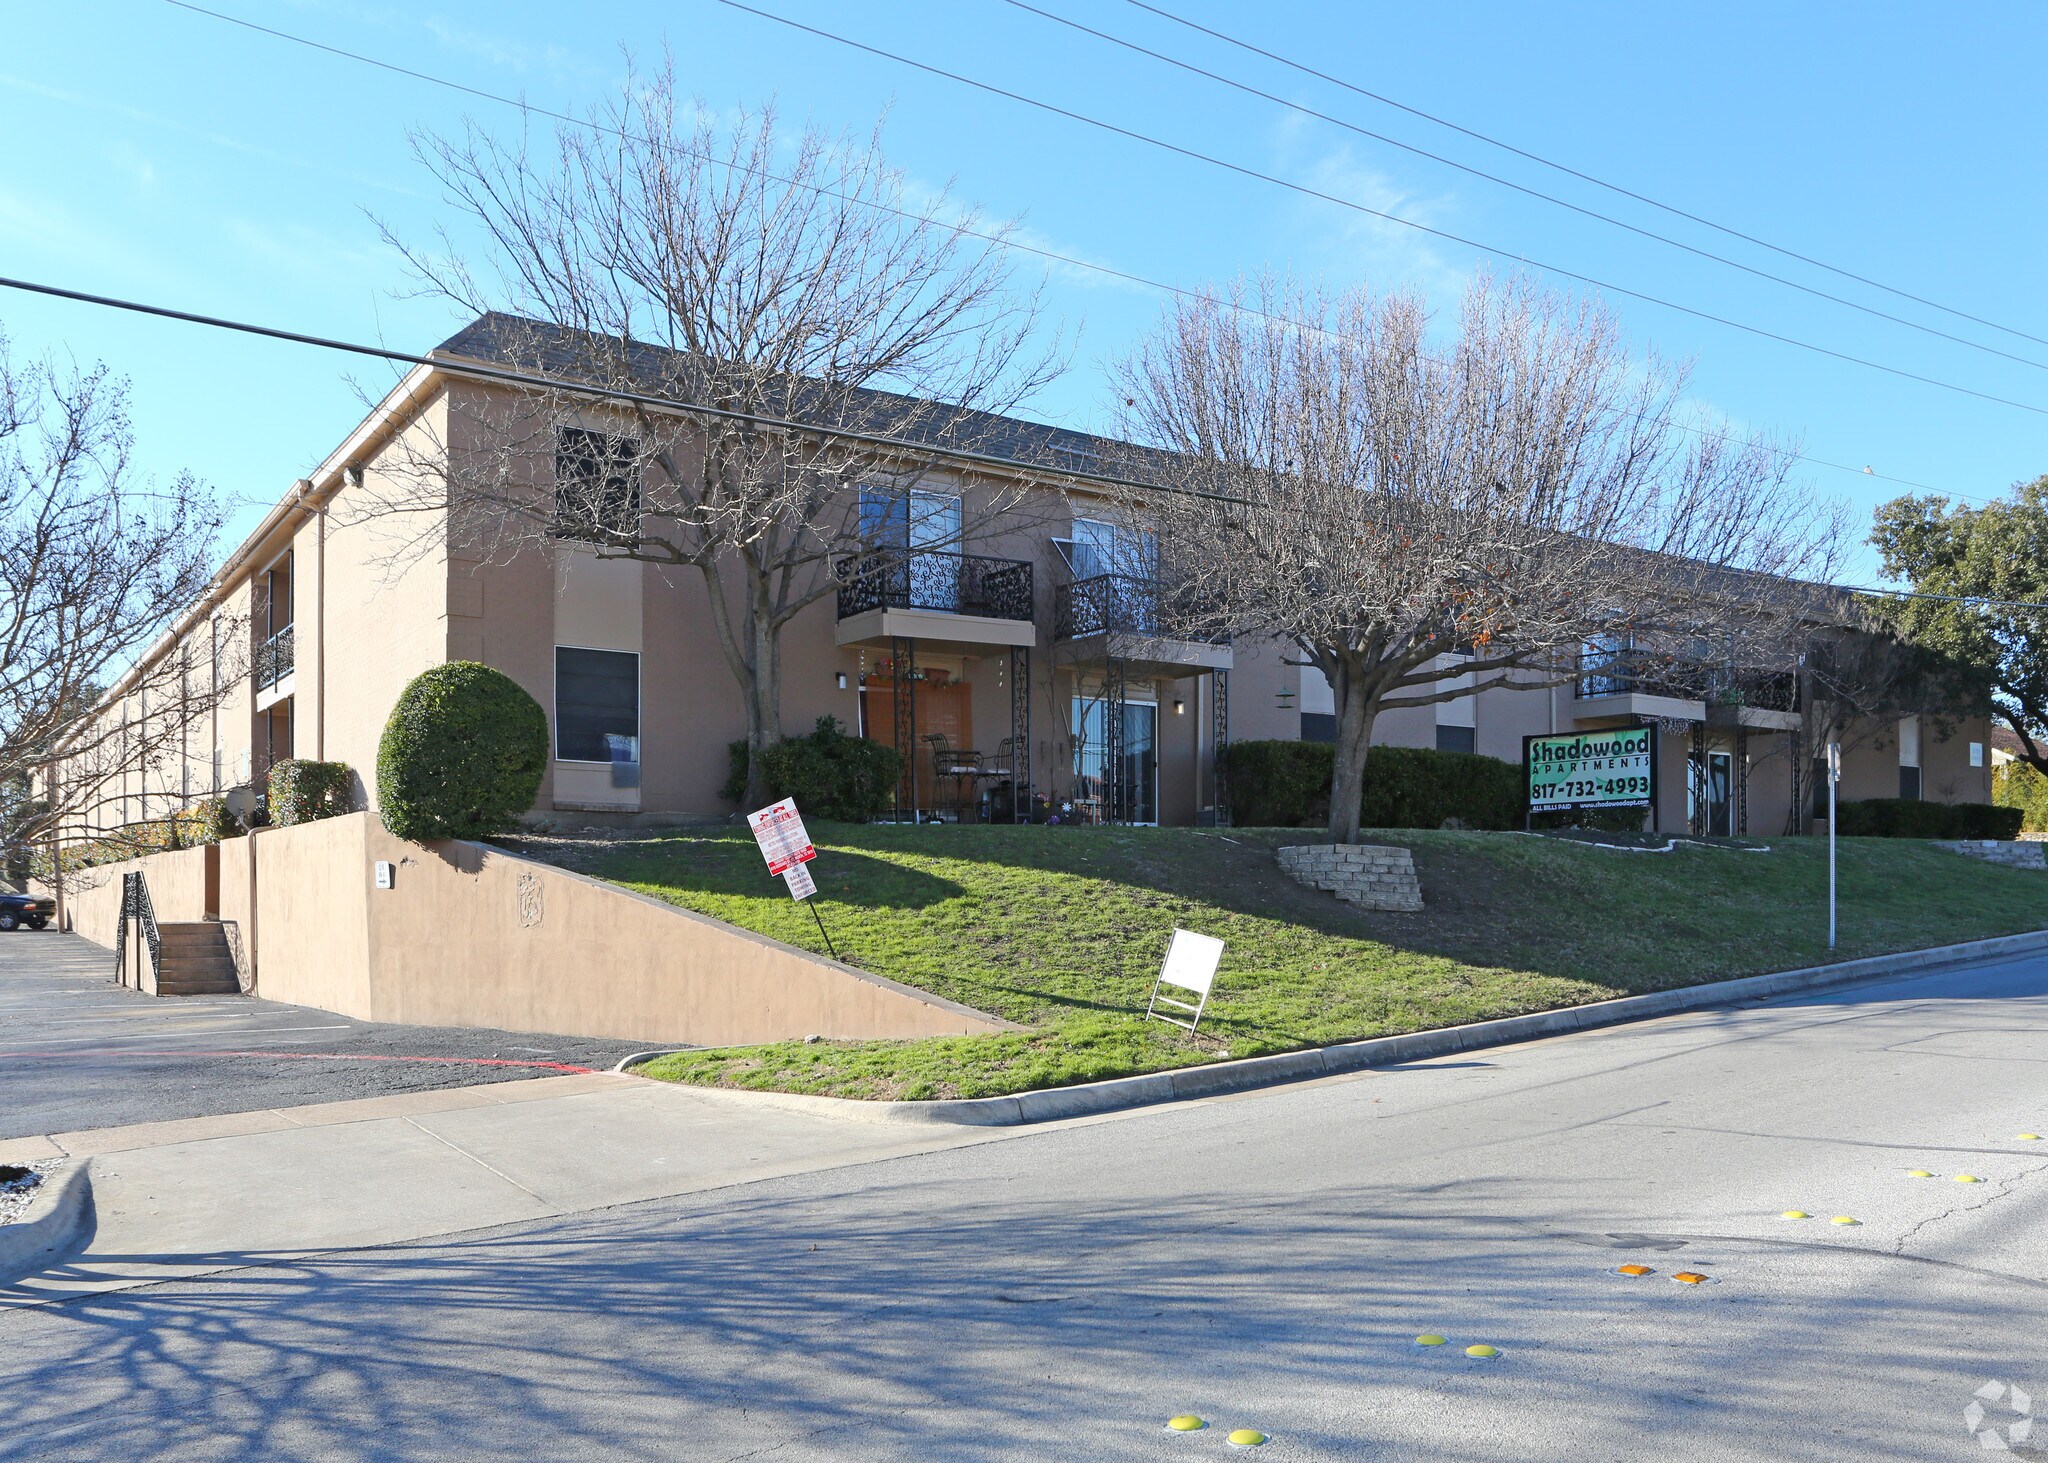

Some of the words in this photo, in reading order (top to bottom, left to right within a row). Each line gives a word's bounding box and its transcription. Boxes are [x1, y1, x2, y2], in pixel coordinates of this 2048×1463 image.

[1532, 731, 1649, 763] Shadowood
[1532, 756, 1649, 775] APARTMENTS
[1532, 776, 1649, 799] 817-732-4993
[791, 877, 810, 887] PARKING
